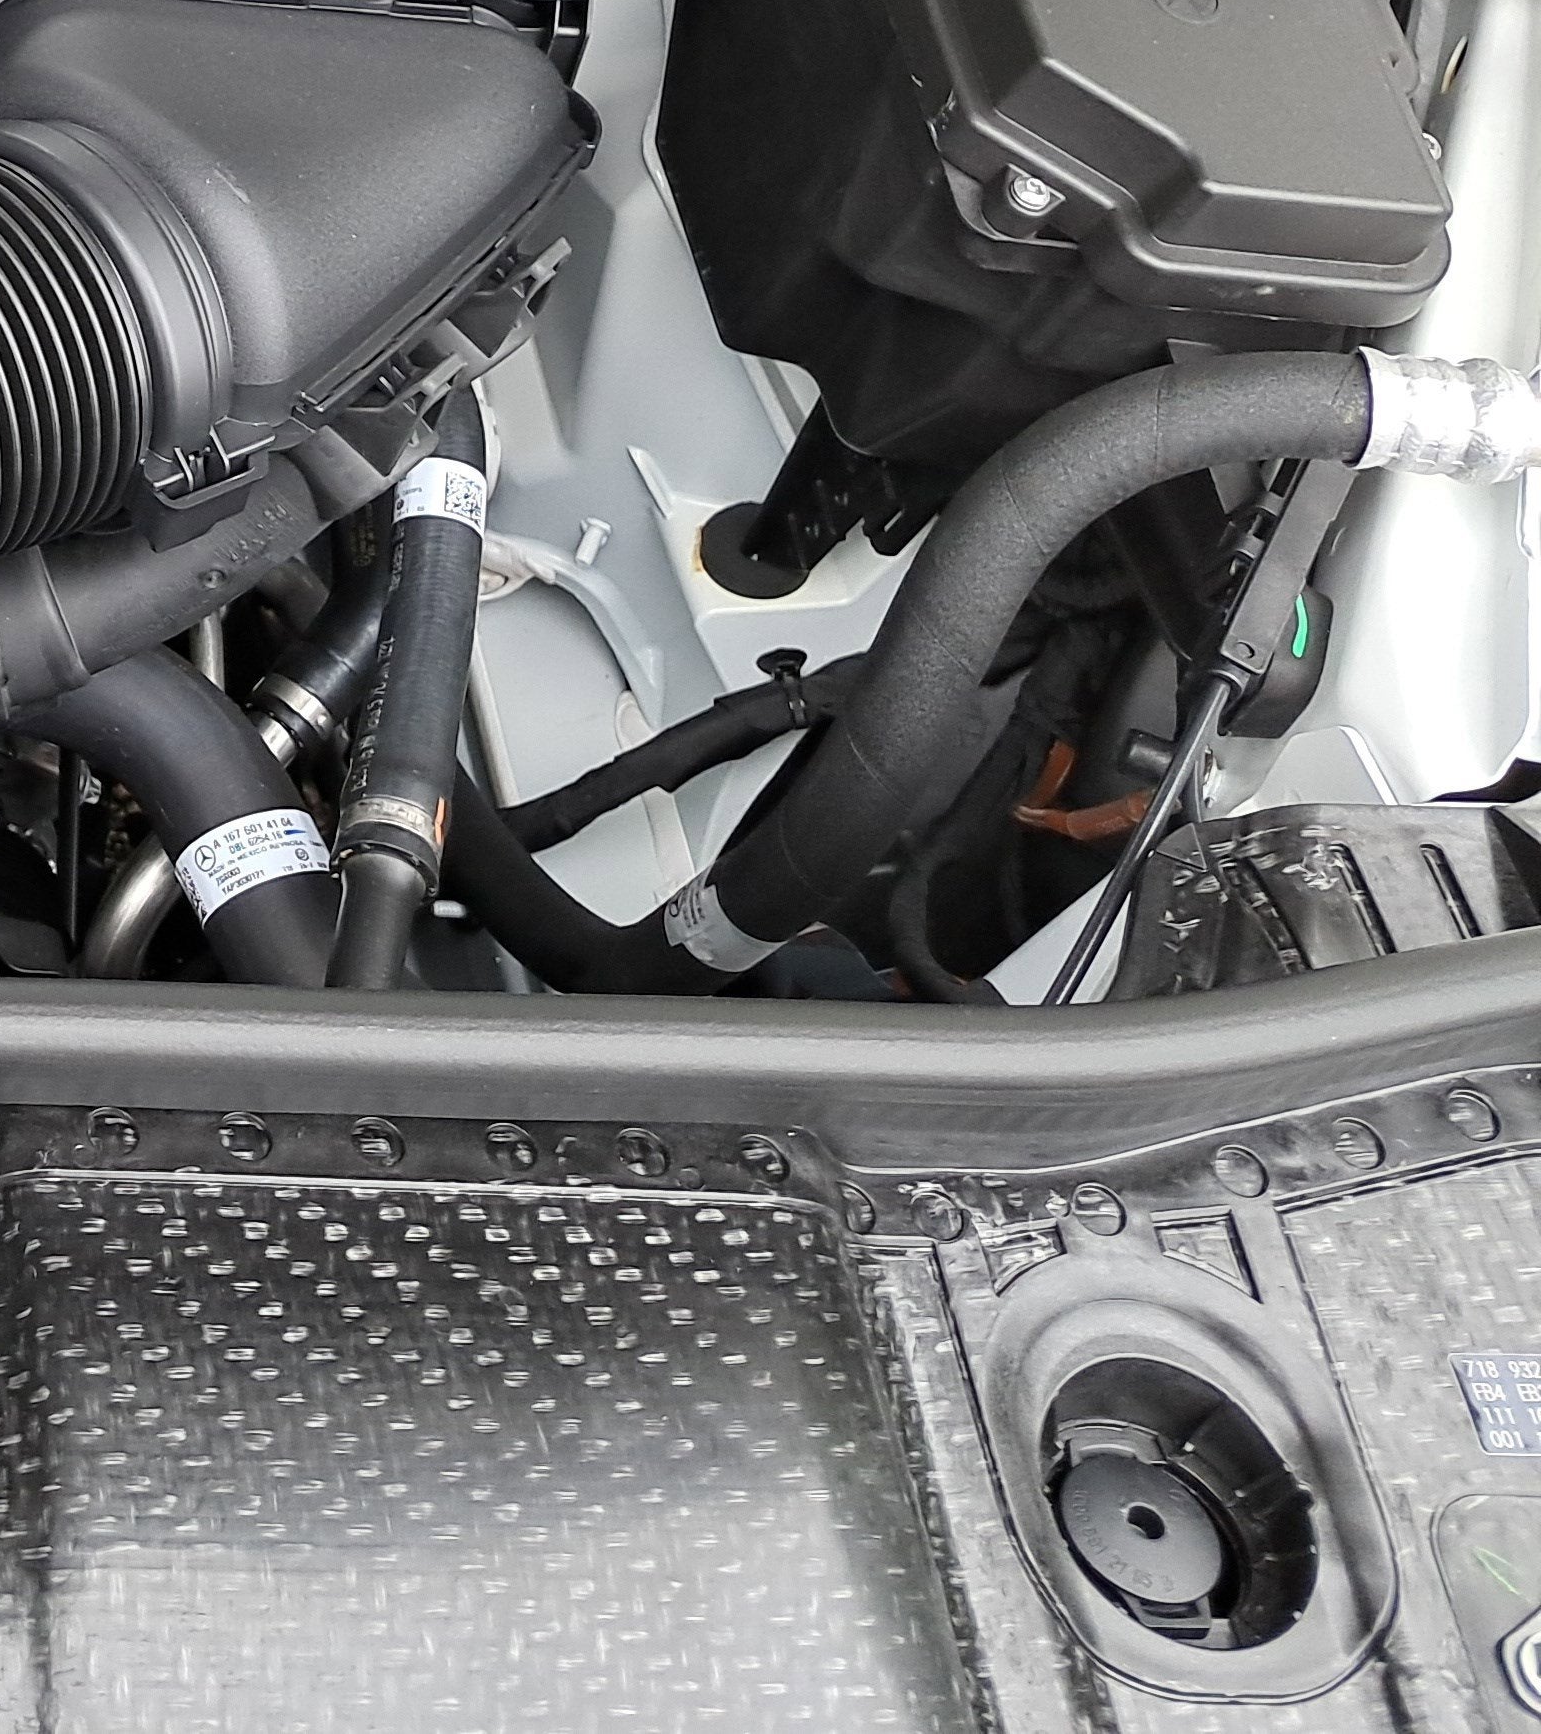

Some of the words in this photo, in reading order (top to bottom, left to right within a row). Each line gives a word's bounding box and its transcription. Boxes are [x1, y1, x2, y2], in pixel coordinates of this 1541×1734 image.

[213, 839, 222, 850] A
[1460, 1359, 1500, 1379] 718
[1482, 1407, 1517, 1426] 111
[1488, 1429, 1525, 1449] 001
